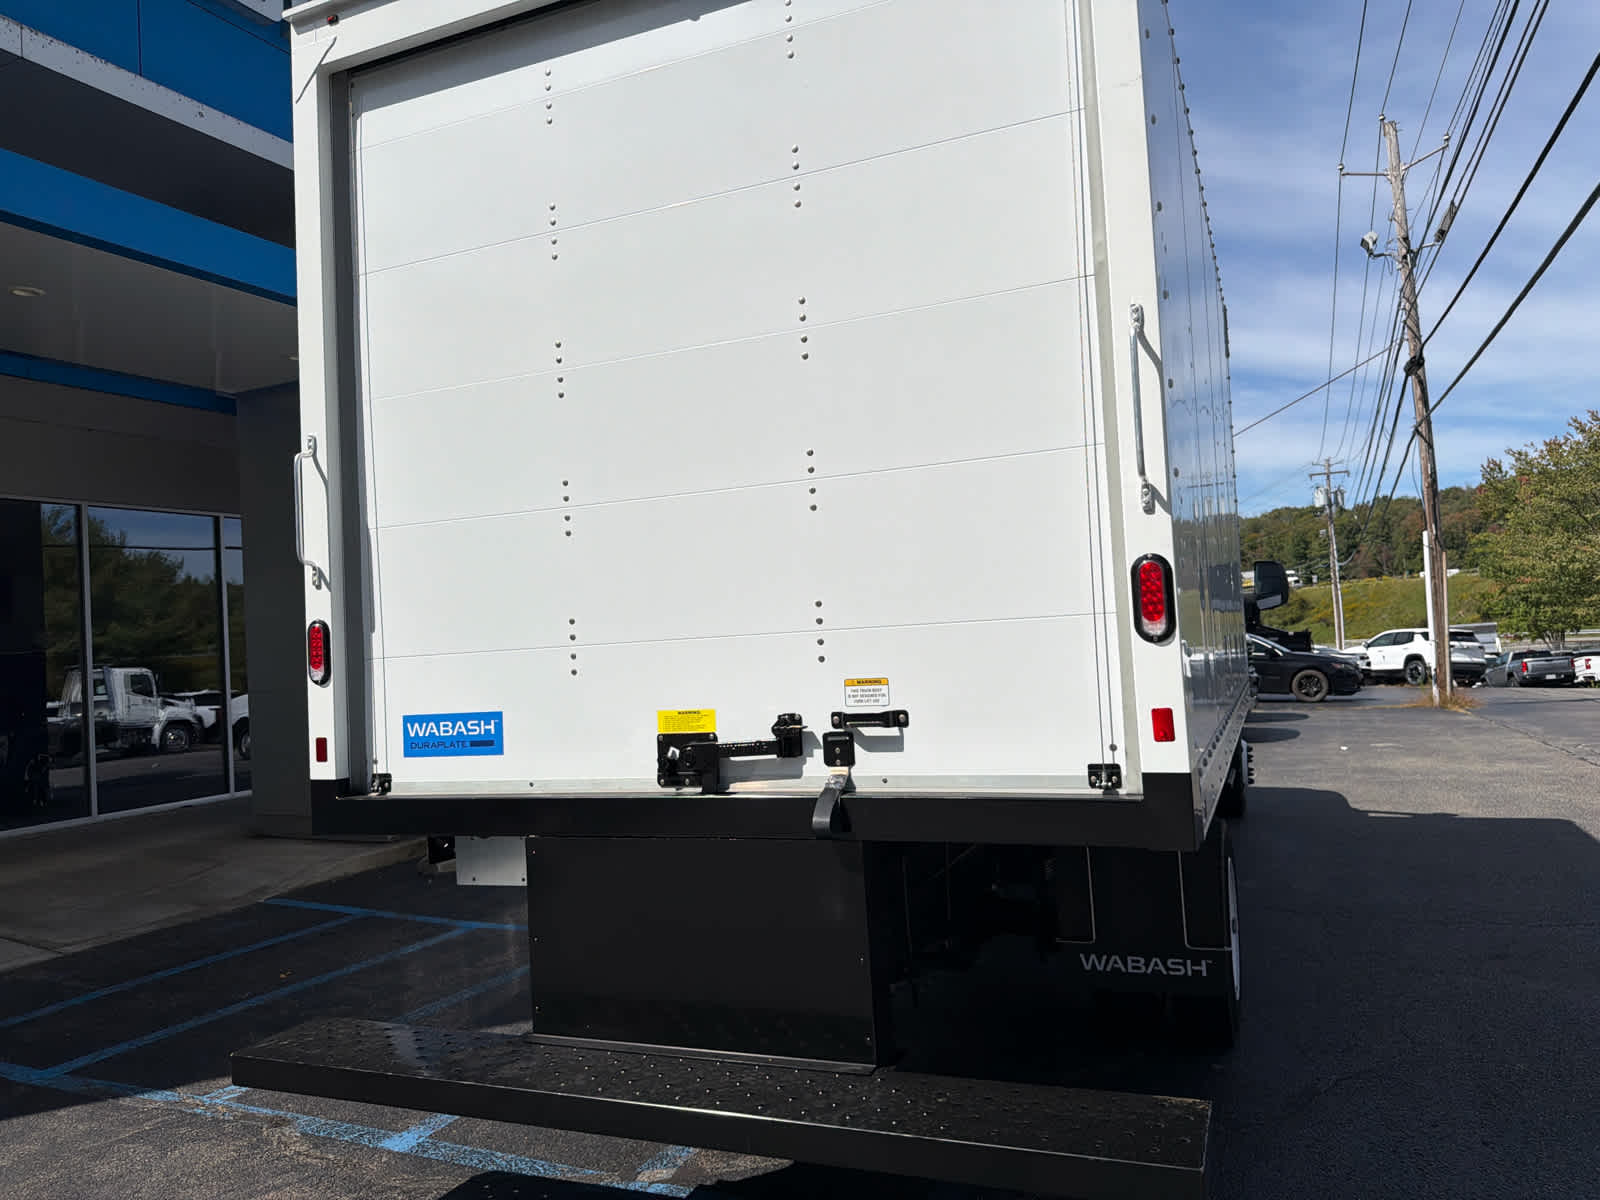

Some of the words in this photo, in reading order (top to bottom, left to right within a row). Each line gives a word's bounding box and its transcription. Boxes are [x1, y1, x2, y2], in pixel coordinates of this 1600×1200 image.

[407, 720, 495, 737] WABASH
[410, 741, 468, 750] DURAPLATE
[1079, 953, 1208, 977] WABASH
